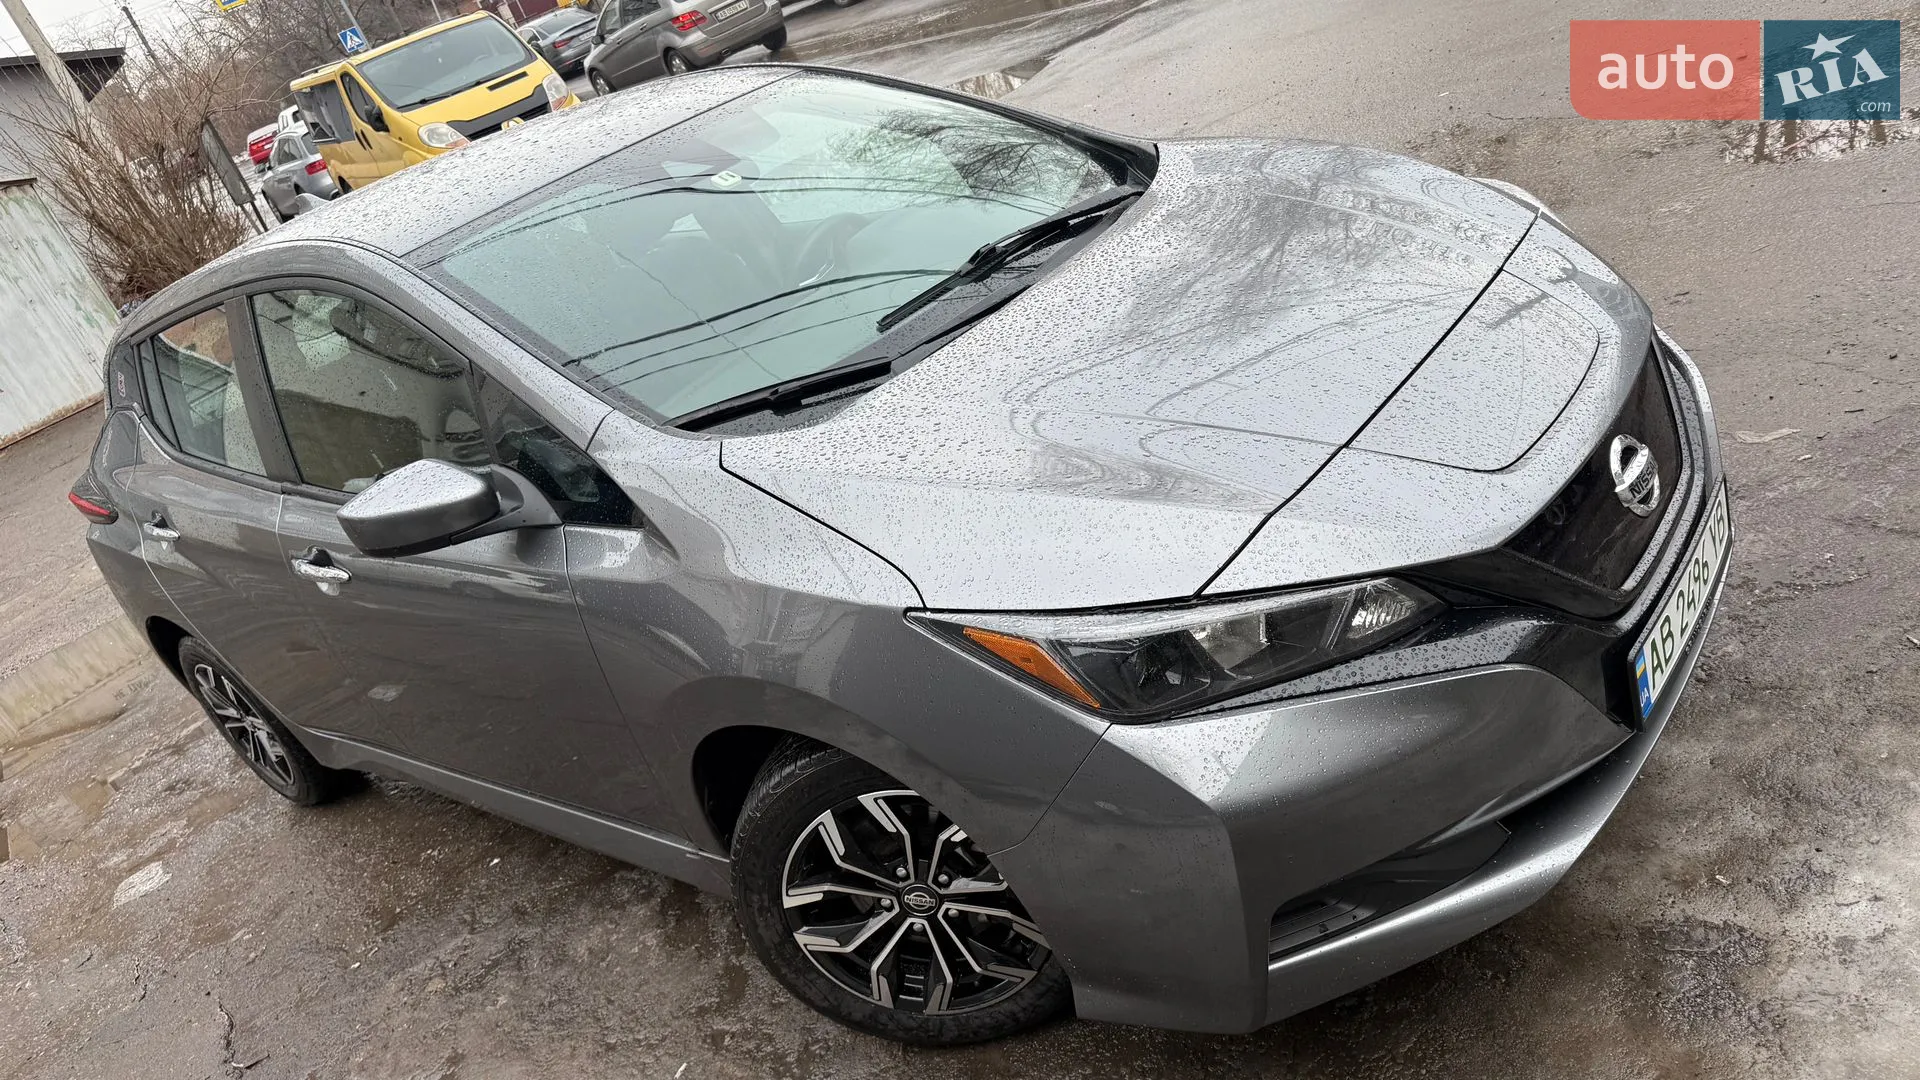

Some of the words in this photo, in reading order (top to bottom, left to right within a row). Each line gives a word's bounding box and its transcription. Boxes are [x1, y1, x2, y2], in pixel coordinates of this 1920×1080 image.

[1650, 614, 1674, 690] AB
[1677, 539, 1709, 639] 2496
[1709, 499, 1724, 560] YB
[1640, 687, 1649, 707] UA
[904, 895, 935, 906] NISSAN
